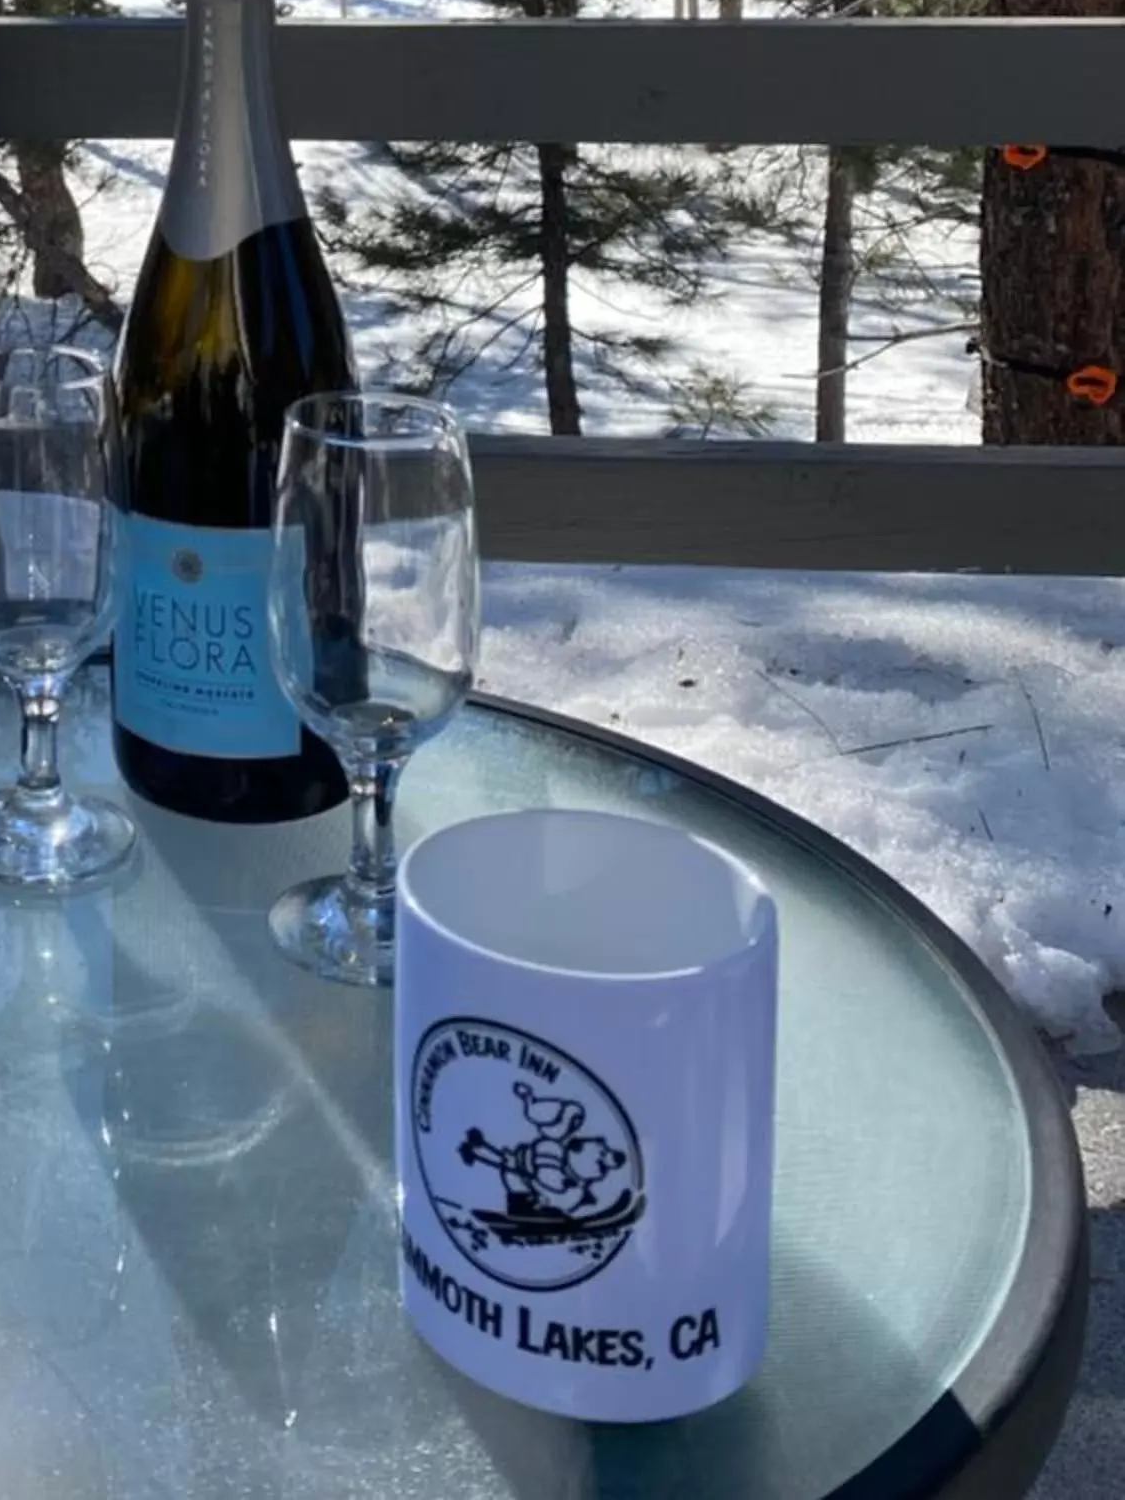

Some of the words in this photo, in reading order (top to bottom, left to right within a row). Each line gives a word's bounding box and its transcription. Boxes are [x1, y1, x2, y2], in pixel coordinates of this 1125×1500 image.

[134, 583, 253, 640] VENUS
[134, 621, 258, 676] FLORA
[455, 1029, 511, 1063] BEAR
[518, 1043, 561, 1084] INN
[516, 1305, 655, 1371] LAKES,
[669, 1307, 722, 1360] CA
